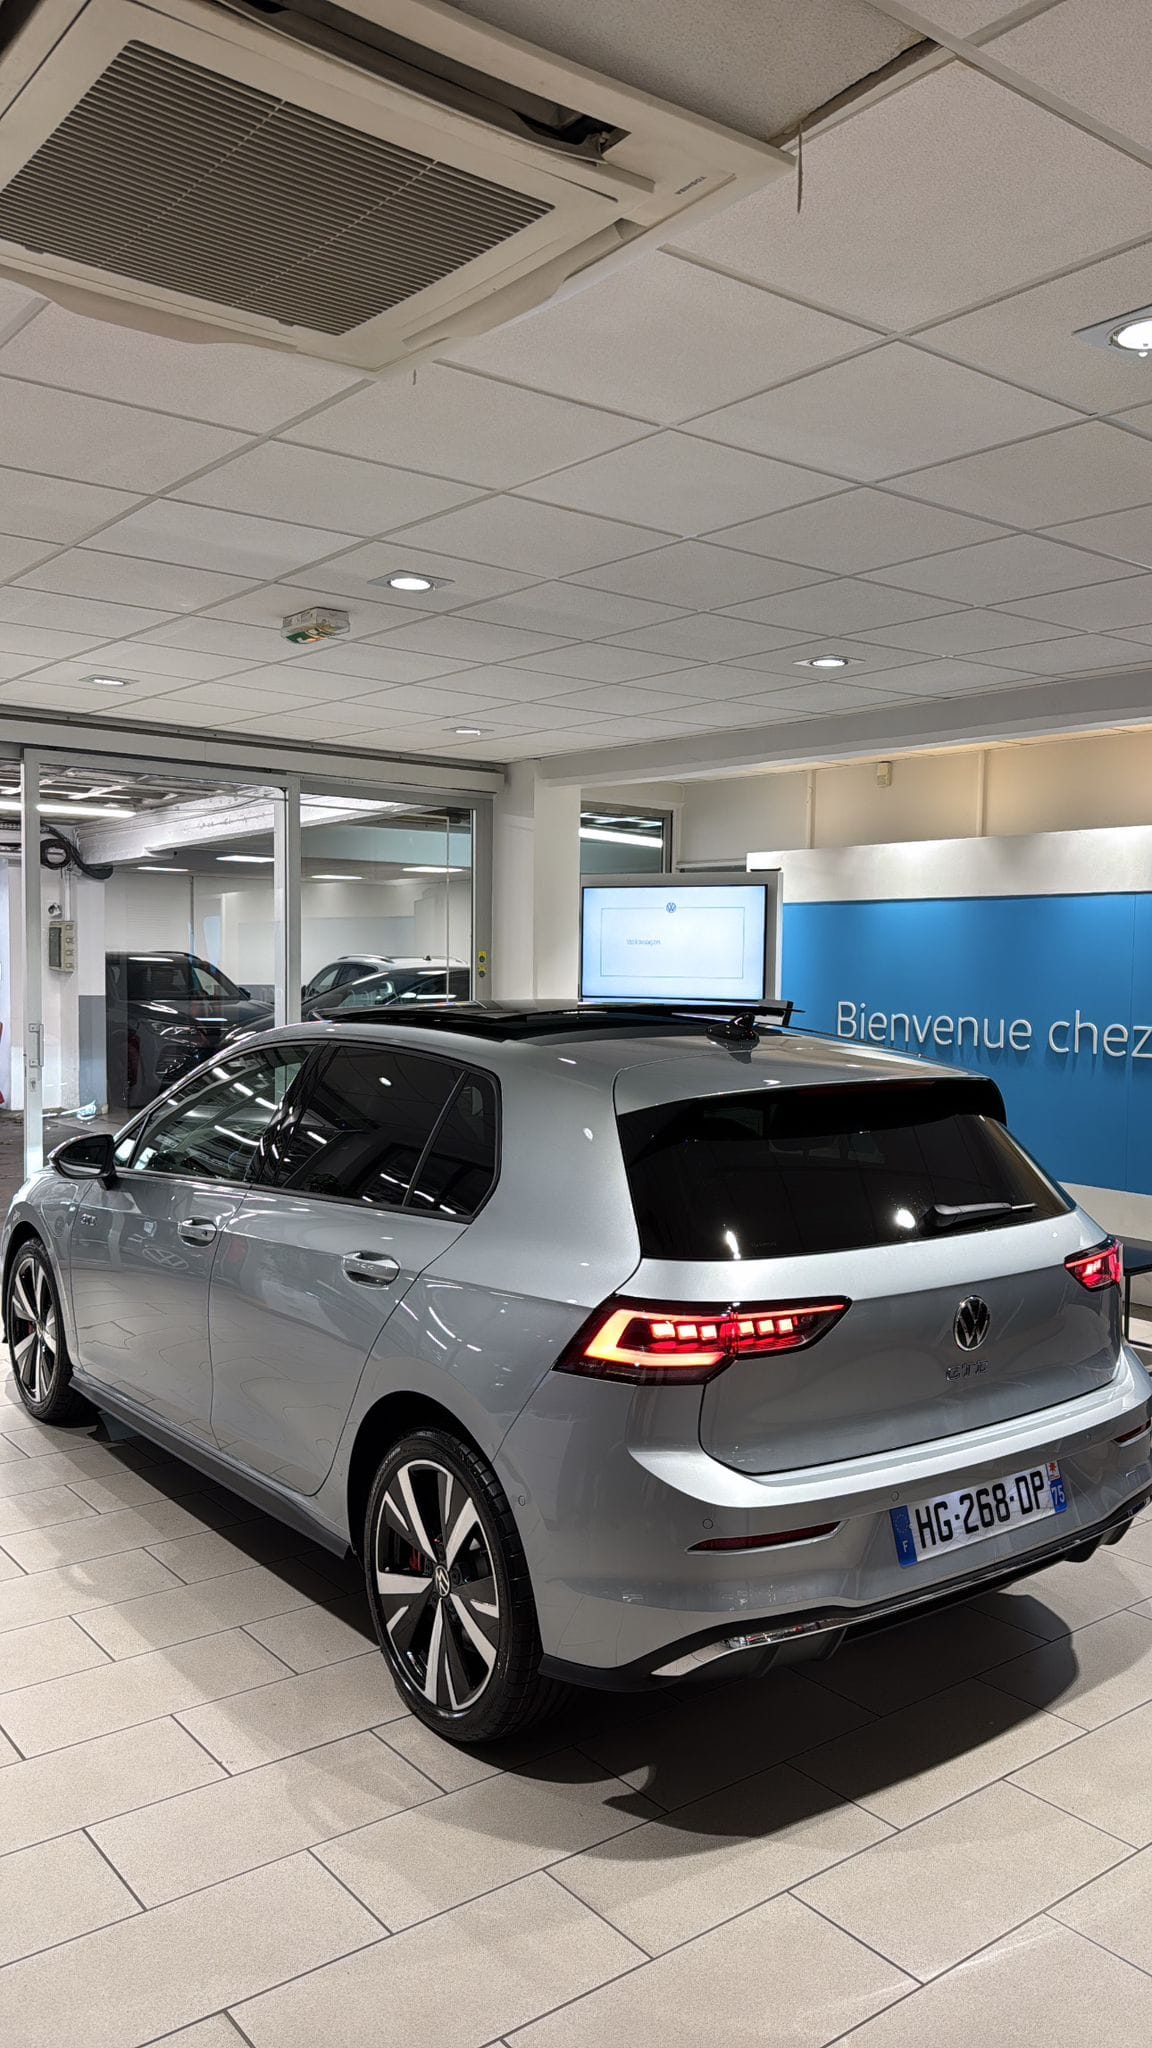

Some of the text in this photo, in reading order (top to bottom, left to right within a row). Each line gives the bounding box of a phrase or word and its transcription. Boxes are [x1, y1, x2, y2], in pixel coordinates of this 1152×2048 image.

[836, 1001, 1152, 1058] Bienvenue chez
[915, 1470, 1044, 1548] HG-268-DP
[1051, 1484, 1065, 1505] 75
[902, 1540, 909, 1552] F
